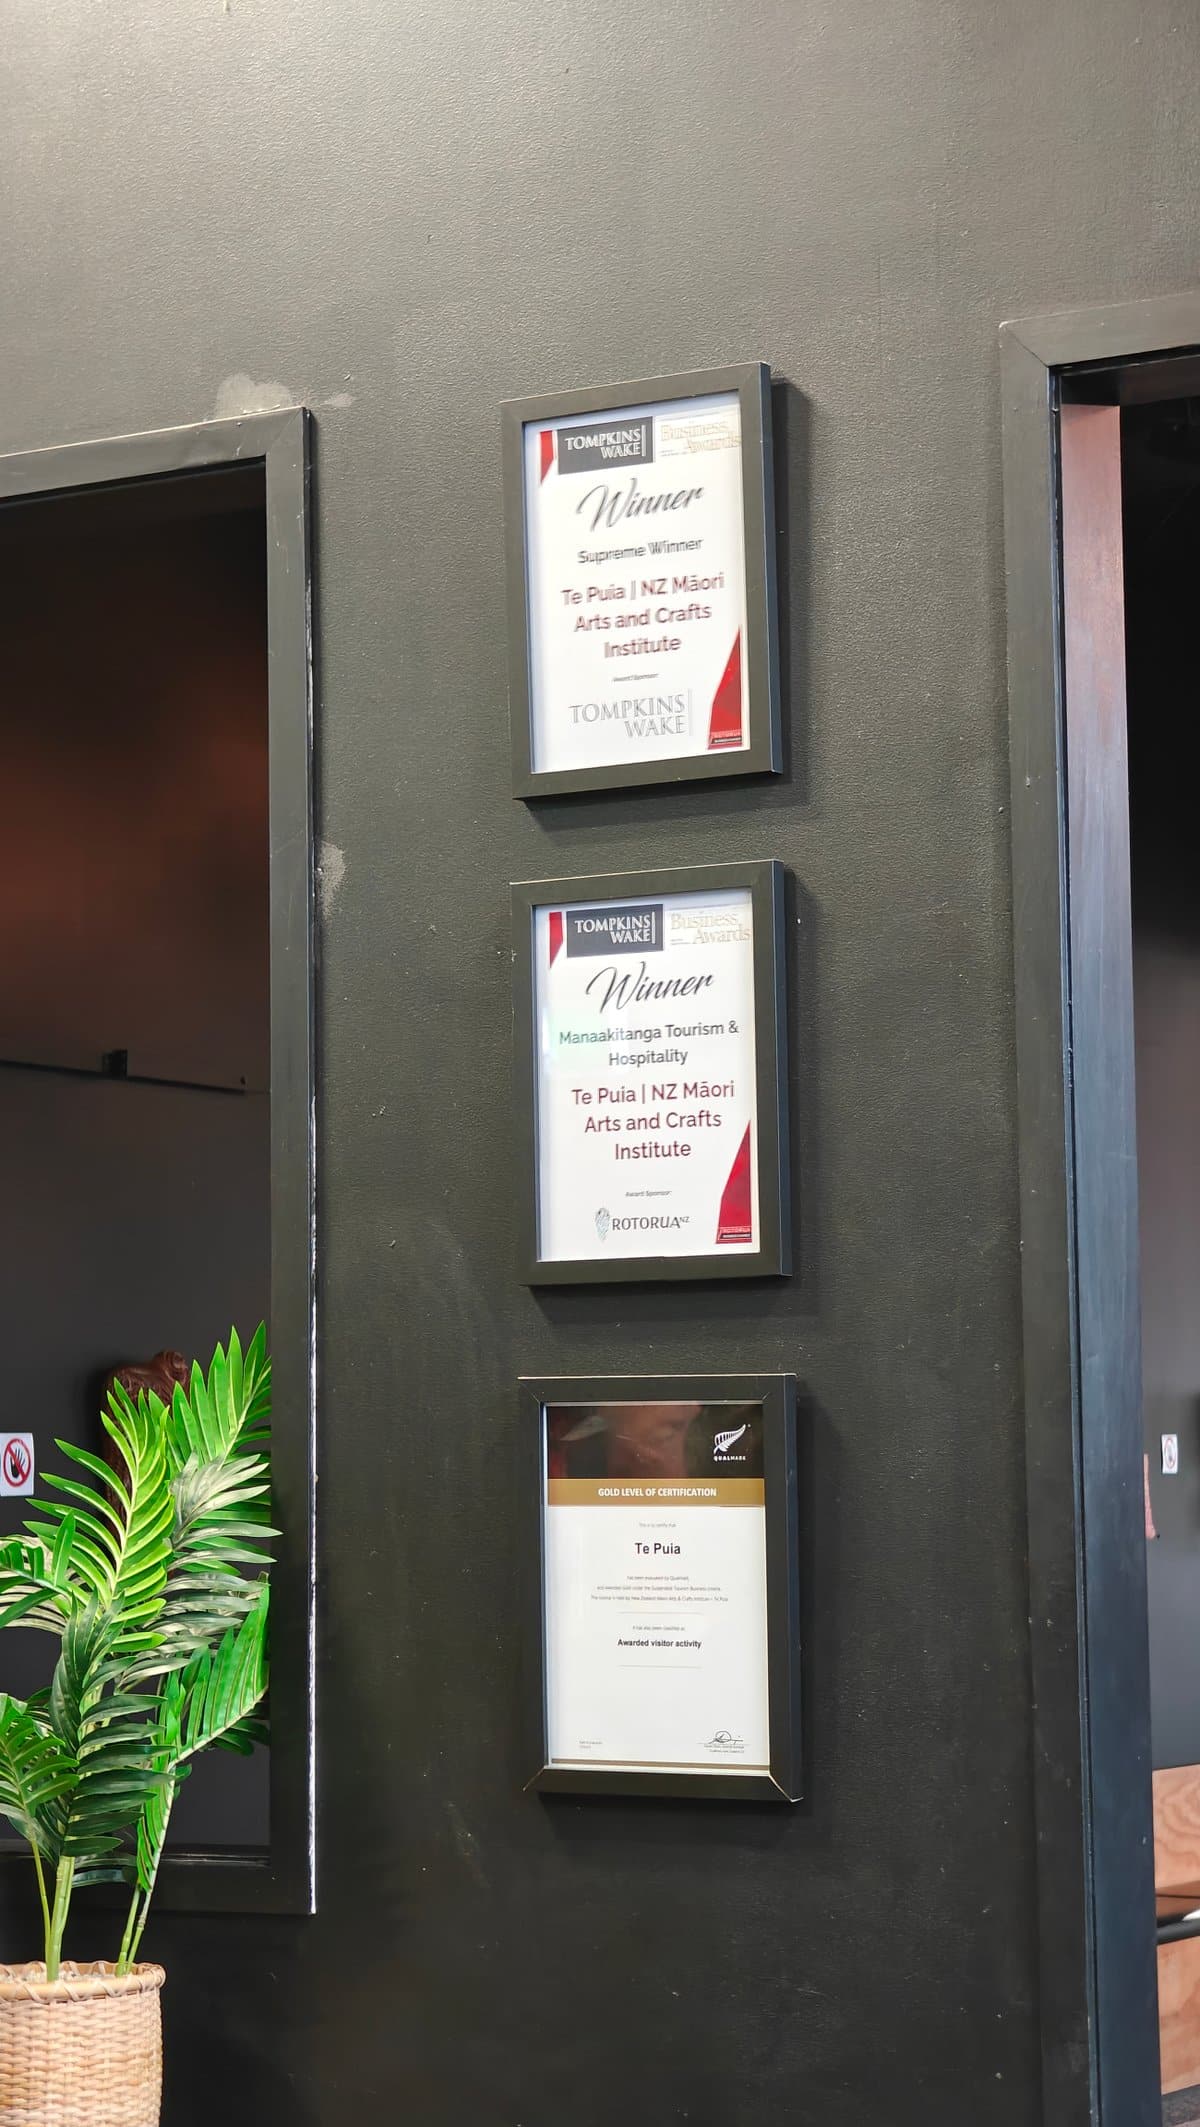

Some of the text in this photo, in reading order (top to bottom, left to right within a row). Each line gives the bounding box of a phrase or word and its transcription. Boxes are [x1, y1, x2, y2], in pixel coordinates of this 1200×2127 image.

[565, 428, 641, 450] TOMPKINS
[601, 442, 640, 459] WAKE
[576, 478, 704, 532] Winner
[577, 539, 704, 565] Supreme Winner
[561, 589, 582, 605] Te
[586, 584, 626, 602] Puia
[640, 578, 667, 596] NZ
[672, 572, 725, 593] Māori
[574, 603, 712, 632] Arts and Crafts
[604, 635, 682, 658] Institute
[568, 694, 685, 723] TOMPKINS
[624, 715, 686, 737] WAKE
[574, 914, 650, 934] TOMPKINS
[610, 929, 650, 944] WAKE
[585, 961, 713, 1014] Winner
[559, 1020, 739, 1045] Manaakitanga Tourism &
[608, 1049, 688, 1067] Hospitality
[571, 1089, 592, 1105] Te
[598, 1085, 636, 1104] Puia
[651, 1084, 677, 1100] NZ
[683, 1080, 735, 1098] Māori
[584, 1110, 722, 1133] Arts and Crafts
[615, 1140, 692, 1160] Institute
[598, 1487, 717, 1497] GOLD LEVEL OF CERTIFICATION
[635, 1542, 681, 1555] Te Puia
[617, 1639, 702, 1649] Awarded visitor activity
